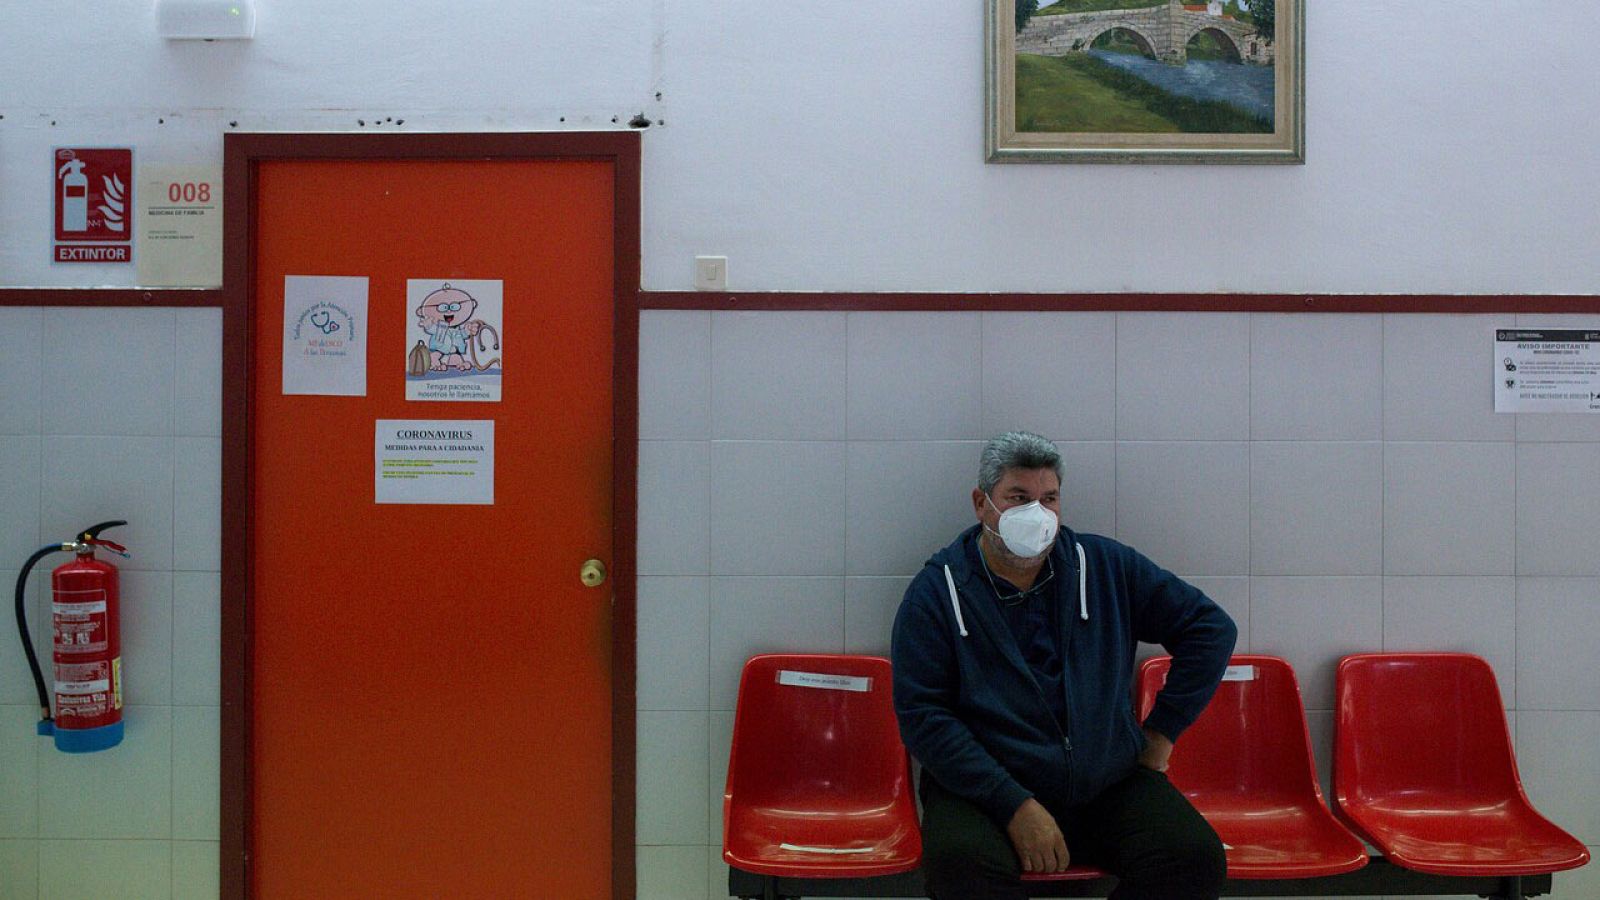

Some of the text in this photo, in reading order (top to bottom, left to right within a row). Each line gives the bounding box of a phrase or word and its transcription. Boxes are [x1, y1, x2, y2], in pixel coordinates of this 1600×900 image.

[168, 182, 210, 203] 008
[59, 248, 126, 260] EXTINTOR
[426, 383, 482, 392] Tenga paciencia,
[448, 390, 455, 398] le
[456, 390, 490, 399] llamamos
[396, 429, 473, 440] CORONAVIRUS
